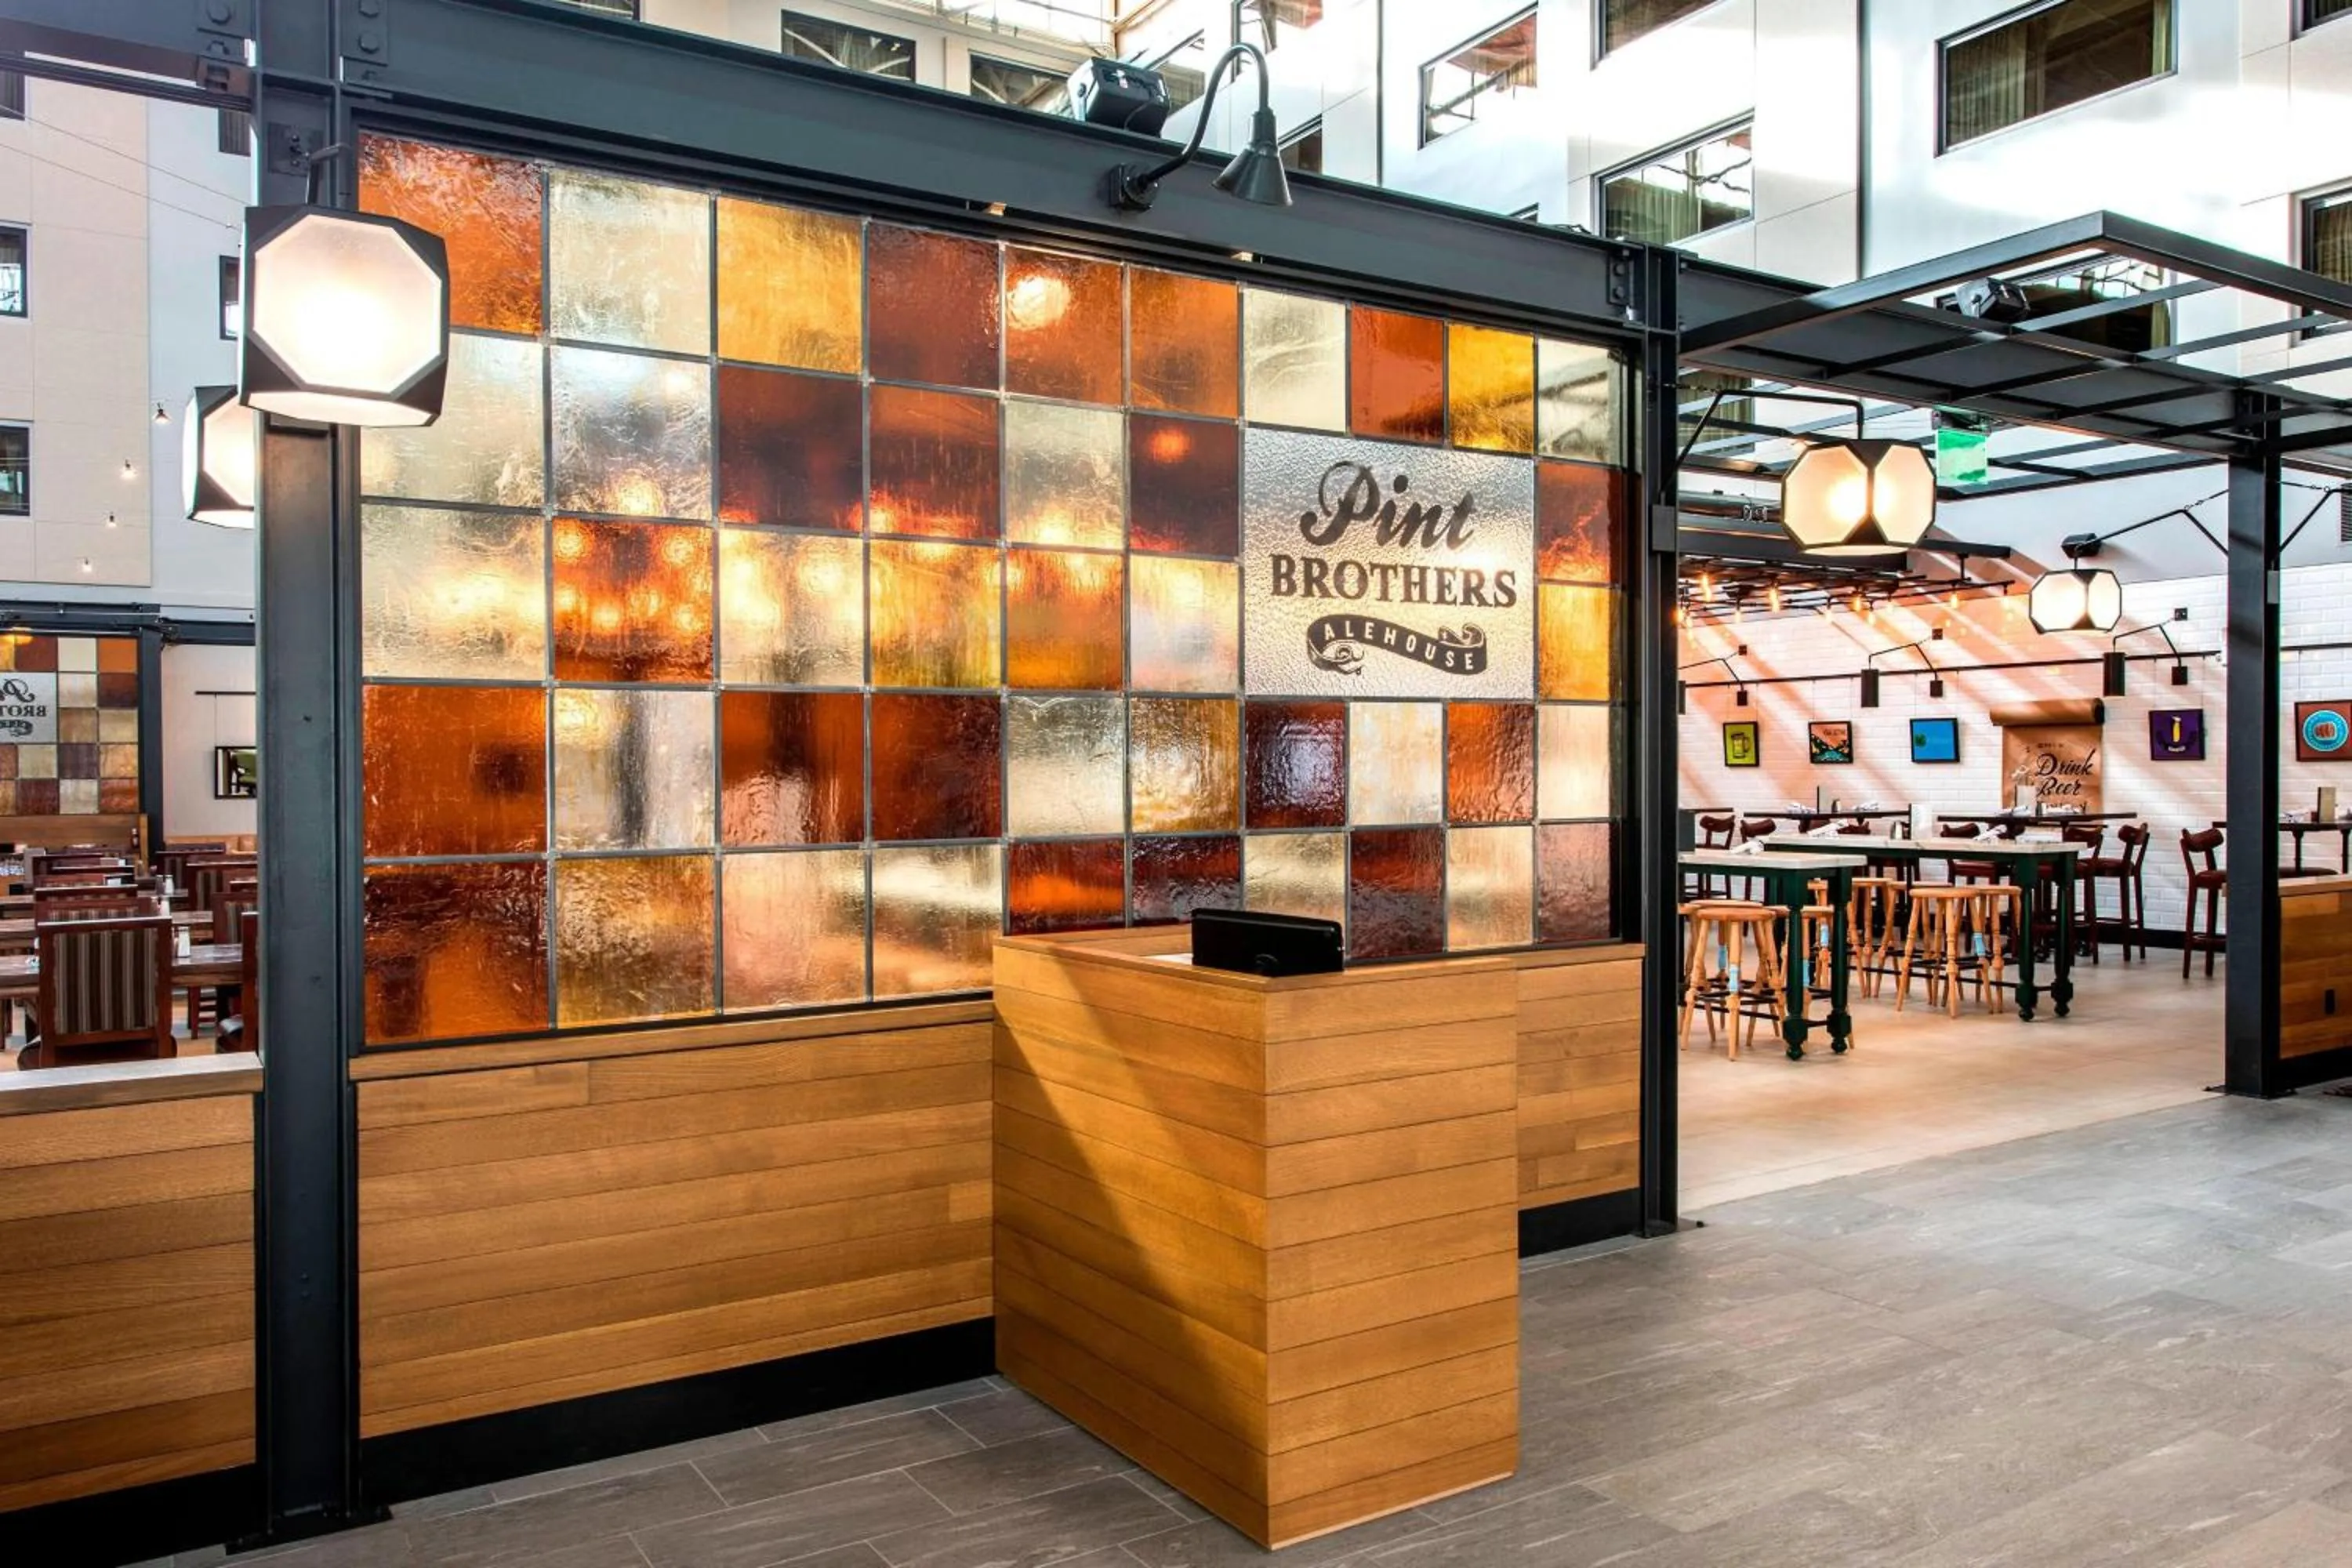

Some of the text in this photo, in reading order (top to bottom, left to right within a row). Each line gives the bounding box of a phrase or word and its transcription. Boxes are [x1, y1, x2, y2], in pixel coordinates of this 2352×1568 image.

[1300, 460, 1476, 549] Pint
[1269, 554, 1518, 608] BROTHERS
[1324, 620, 1474, 671] ALEHOUSE
[2034, 747, 2096, 777] Drink
[2036, 776, 2082, 797] Beer
